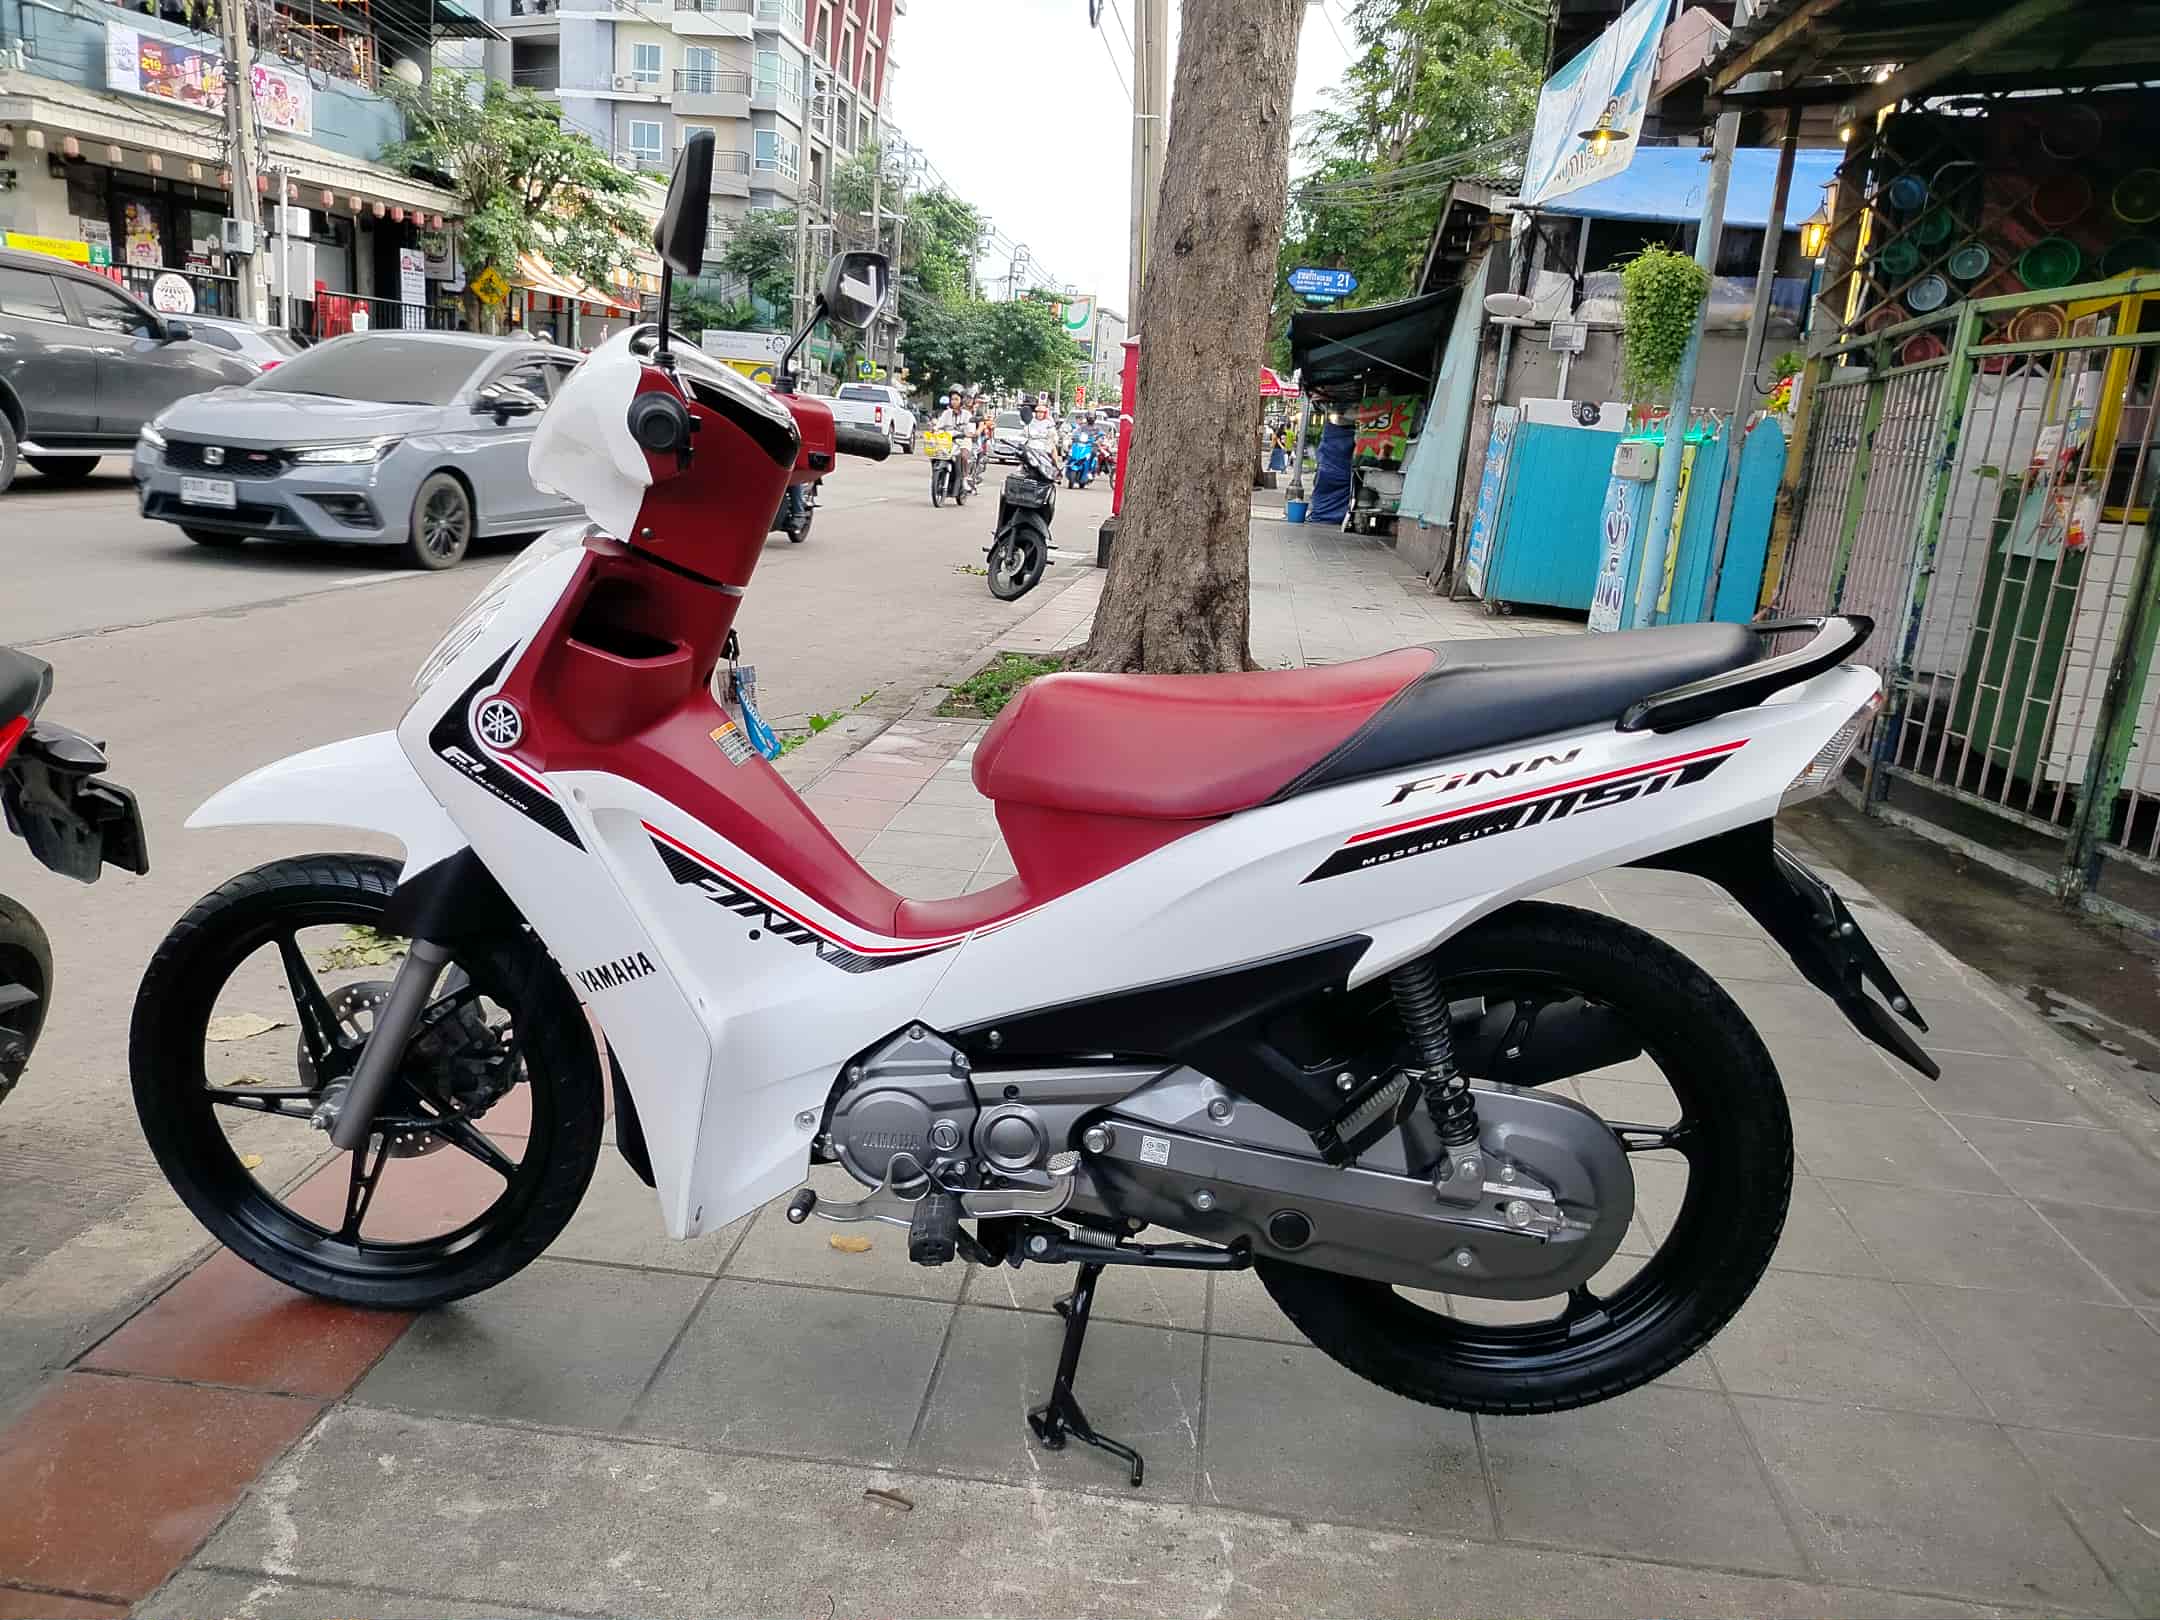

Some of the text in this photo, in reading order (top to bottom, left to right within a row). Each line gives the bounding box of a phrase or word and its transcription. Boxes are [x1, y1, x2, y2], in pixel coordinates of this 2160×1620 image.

[1336, 273, 1350, 288] 21
[441, 745, 487, 773] FI
[475, 774, 528, 810] INJECTION
[1362, 838, 1449, 866] MODERN
[1459, 822, 1509, 841] CITY
[576, 951, 656, 993] YAMAHA
